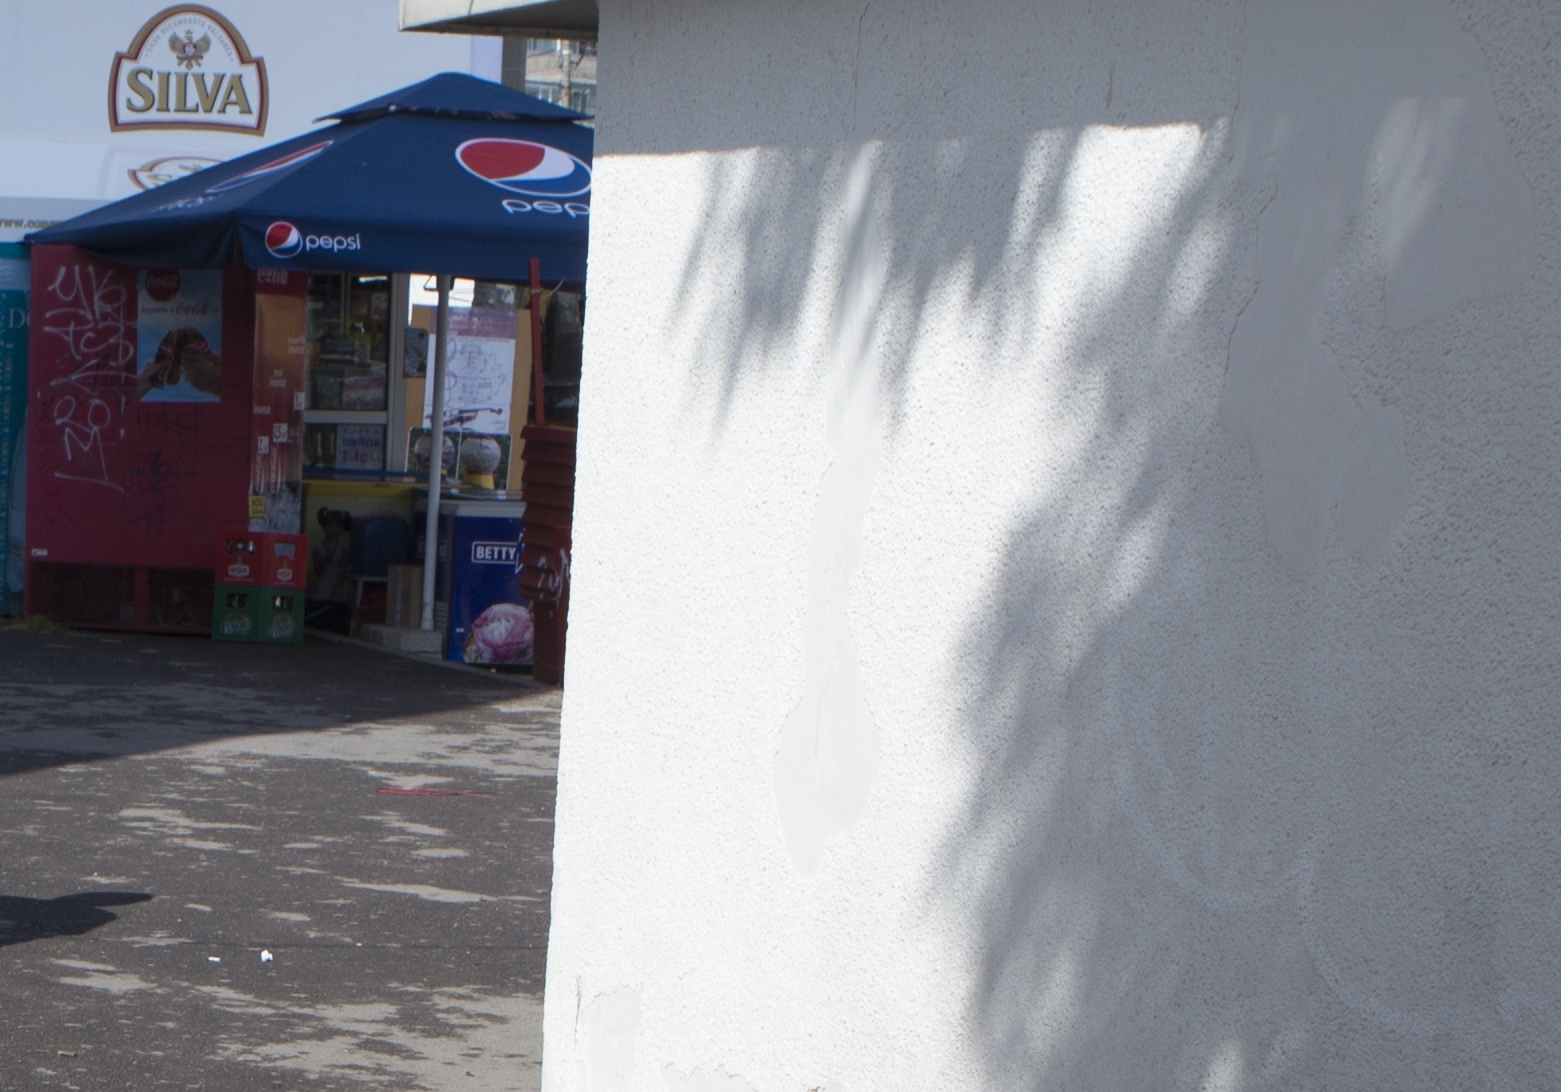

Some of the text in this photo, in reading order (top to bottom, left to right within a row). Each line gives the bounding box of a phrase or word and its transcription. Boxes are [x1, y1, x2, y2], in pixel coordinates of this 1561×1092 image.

[126, 67, 253, 114] SILVA
[501, 199, 590, 218] pep
[306, 233, 361, 252] pepsi
[8, 306, 30, 328] D
[476, 546, 517, 560] BETTY
